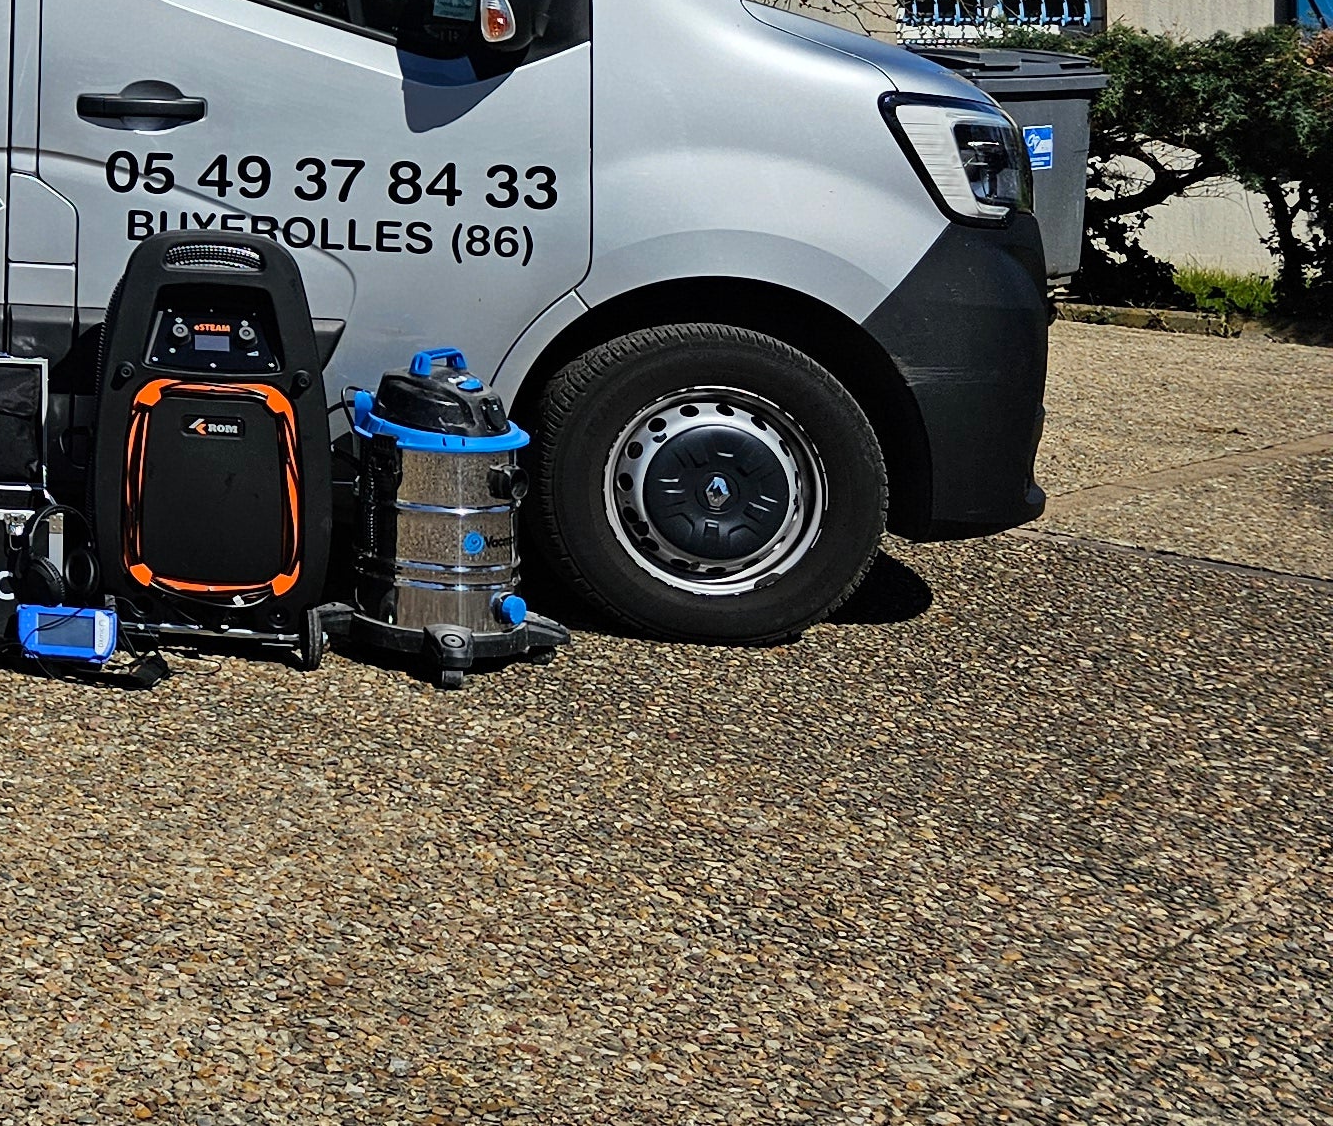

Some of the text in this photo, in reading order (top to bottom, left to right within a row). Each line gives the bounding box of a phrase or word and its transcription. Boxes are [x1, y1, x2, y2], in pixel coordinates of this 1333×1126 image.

[104, 149, 559, 211] 05 49 37 84 33
[450, 222, 535, 267] (86)
[207, 423, 239, 434] ROM
